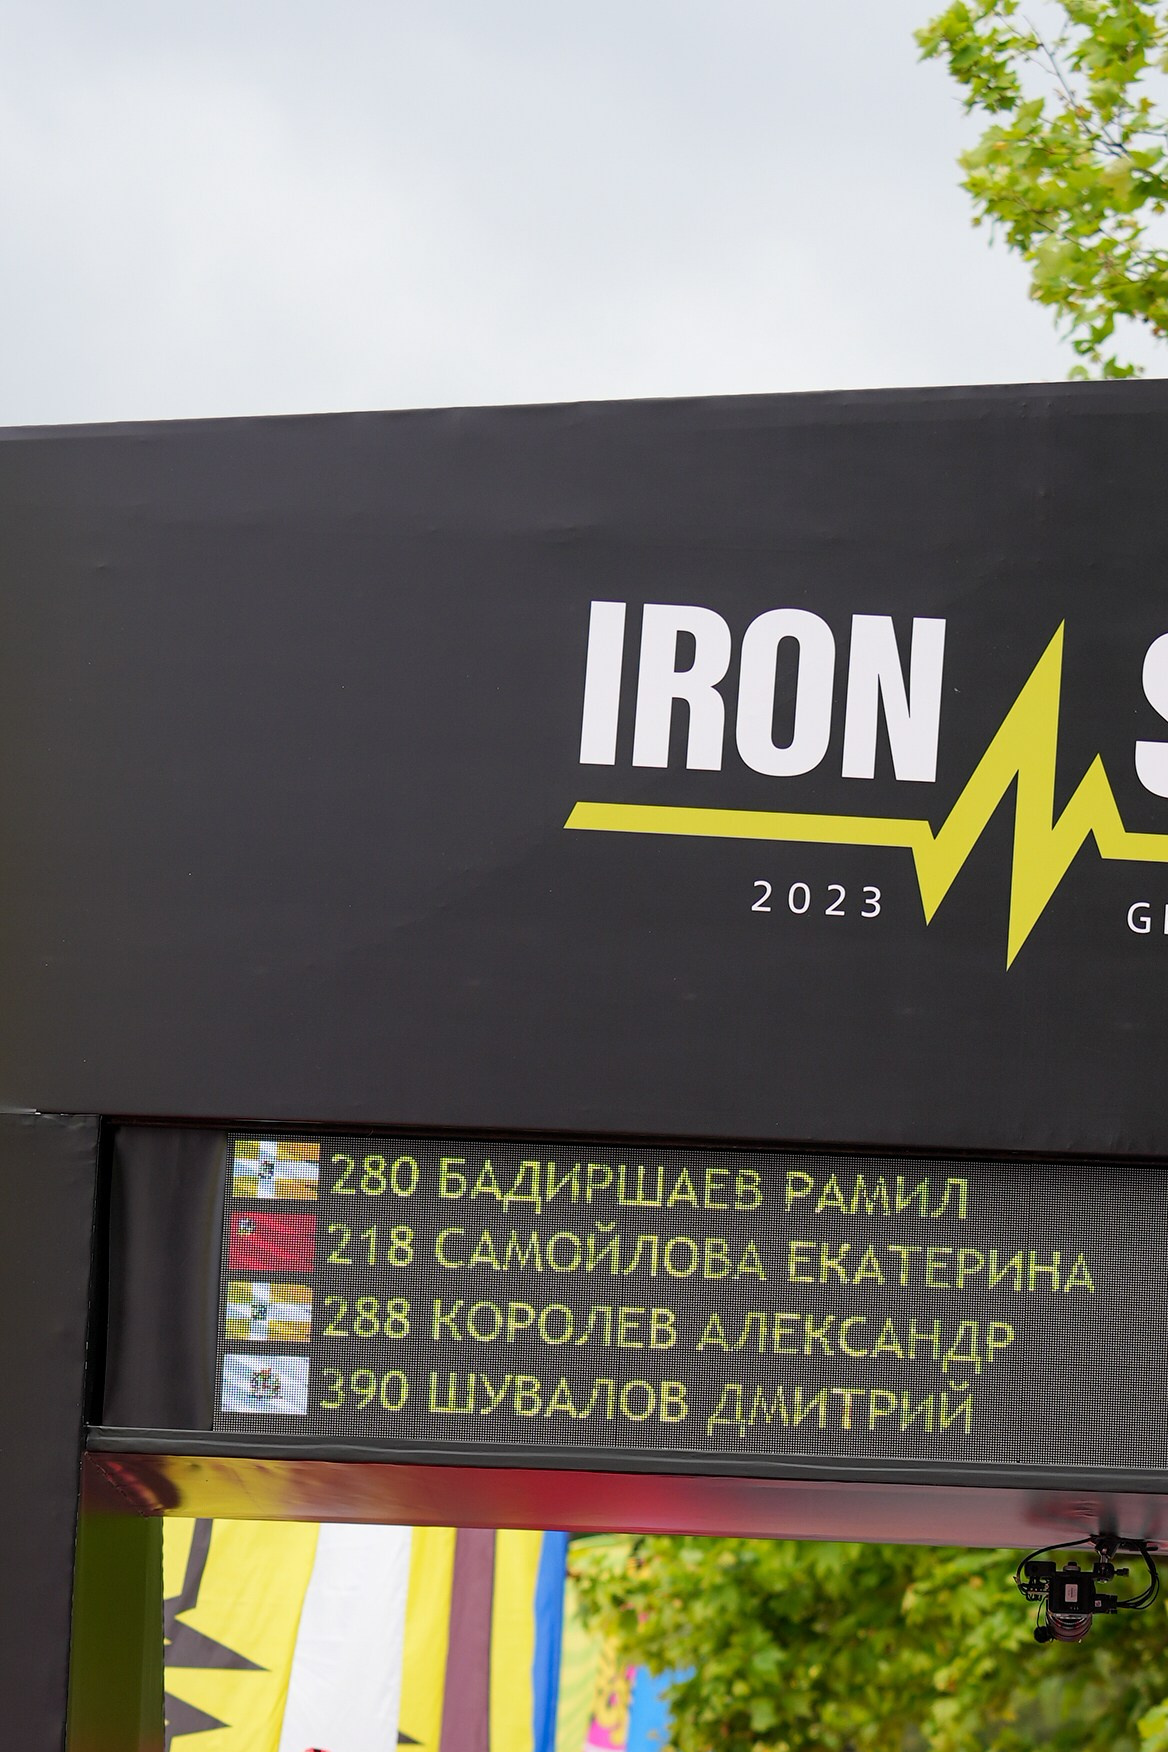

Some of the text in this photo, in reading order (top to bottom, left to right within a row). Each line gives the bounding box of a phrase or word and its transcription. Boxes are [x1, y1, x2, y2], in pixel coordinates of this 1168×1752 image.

[579, 600, 947, 783] IRON
[751, 880, 881, 918] 2023
[331, 1154, 419, 1197] 280
[438, 1157, 763, 1214] БАДИРШАЕВ
[785, 1171, 969, 1220] РАМИЛ
[326, 1223, 414, 1267] 218
[435, 1220, 767, 1281] САМОЙЛОВА
[787, 1241, 1096, 1293] ЕКАТЕРИНА
[323, 1296, 410, 1339] 288
[432, 1299, 677, 1351] КОРОЛЕВ
[696, 1312, 1016, 1374] АЛЕКСАНДР
[319, 1368, 409, 1412] 390
[428, 1371, 689, 1423] ШУВАЛОВ
[707, 1381, 975, 1437] ДМИТРИЙ
